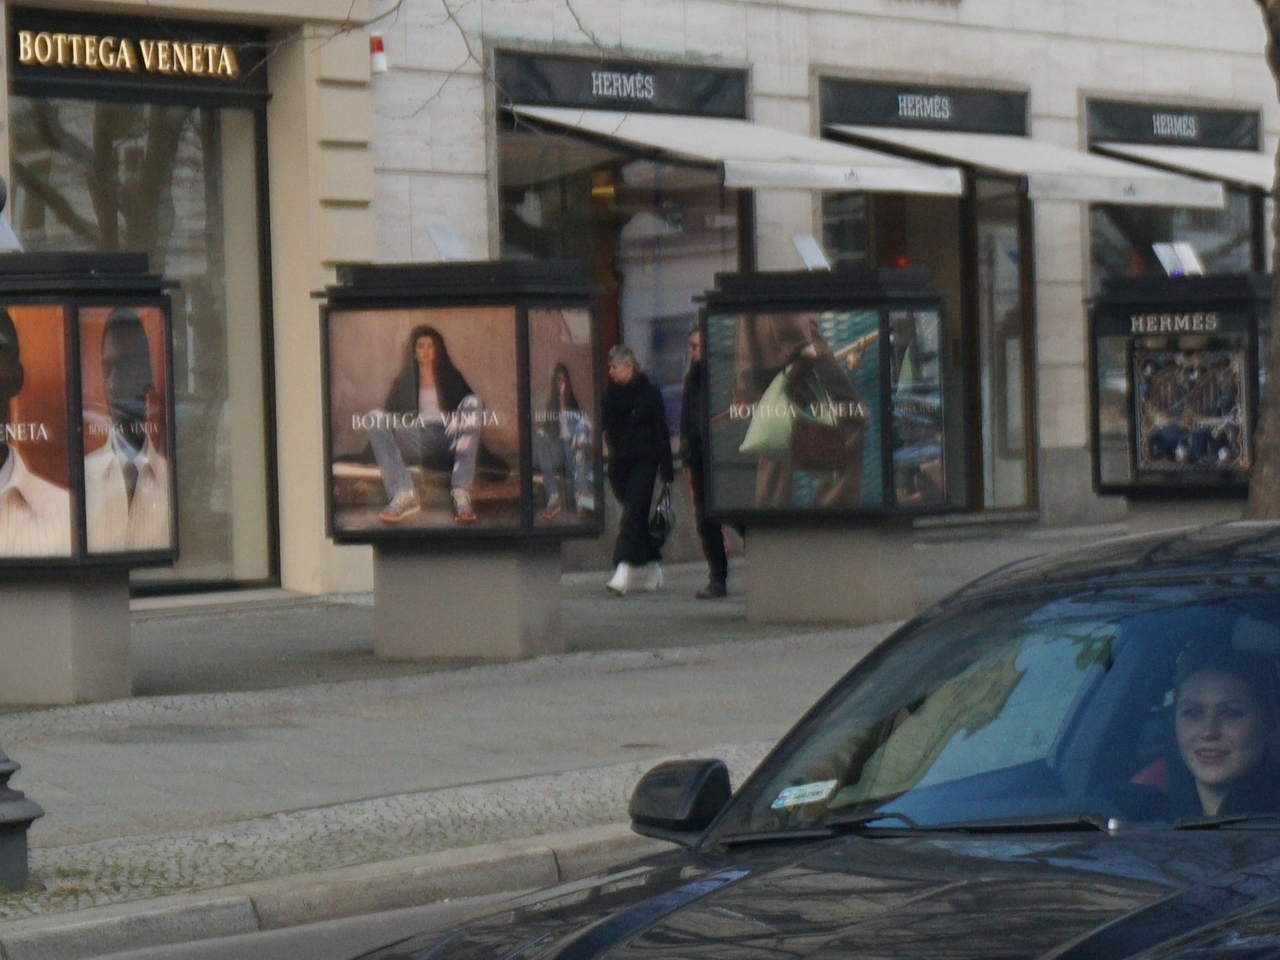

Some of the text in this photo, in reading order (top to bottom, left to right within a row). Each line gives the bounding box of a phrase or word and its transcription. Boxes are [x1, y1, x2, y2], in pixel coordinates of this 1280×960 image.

[18, 30, 235, 76] BOTTEGA VENETA
[351, 410, 500, 430] BOTTEGA VENETA
[729, 402, 865, 419] BOTTEGA VENETA
